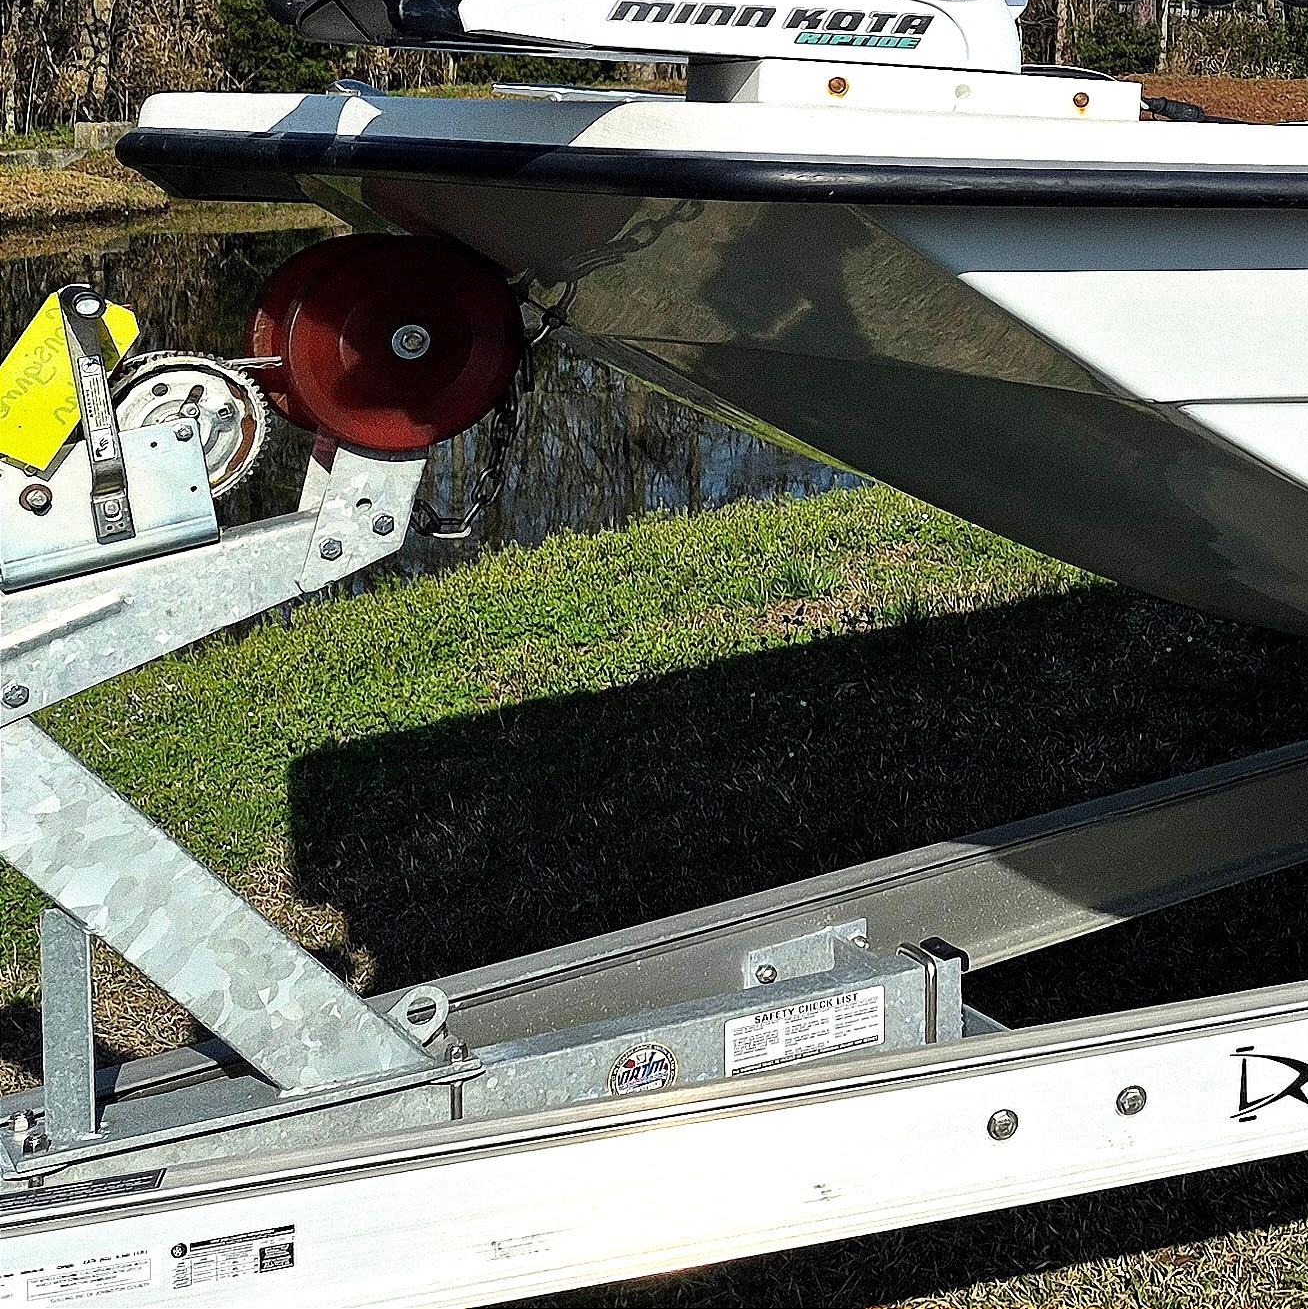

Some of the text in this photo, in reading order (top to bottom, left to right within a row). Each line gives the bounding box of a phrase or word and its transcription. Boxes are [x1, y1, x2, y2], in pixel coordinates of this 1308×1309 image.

[782, 6, 935, 35] KOTA
[795, 31, 921, 49] RIPTIDE
[754, 992, 858, 1024] SAFETY CHECK LIST
